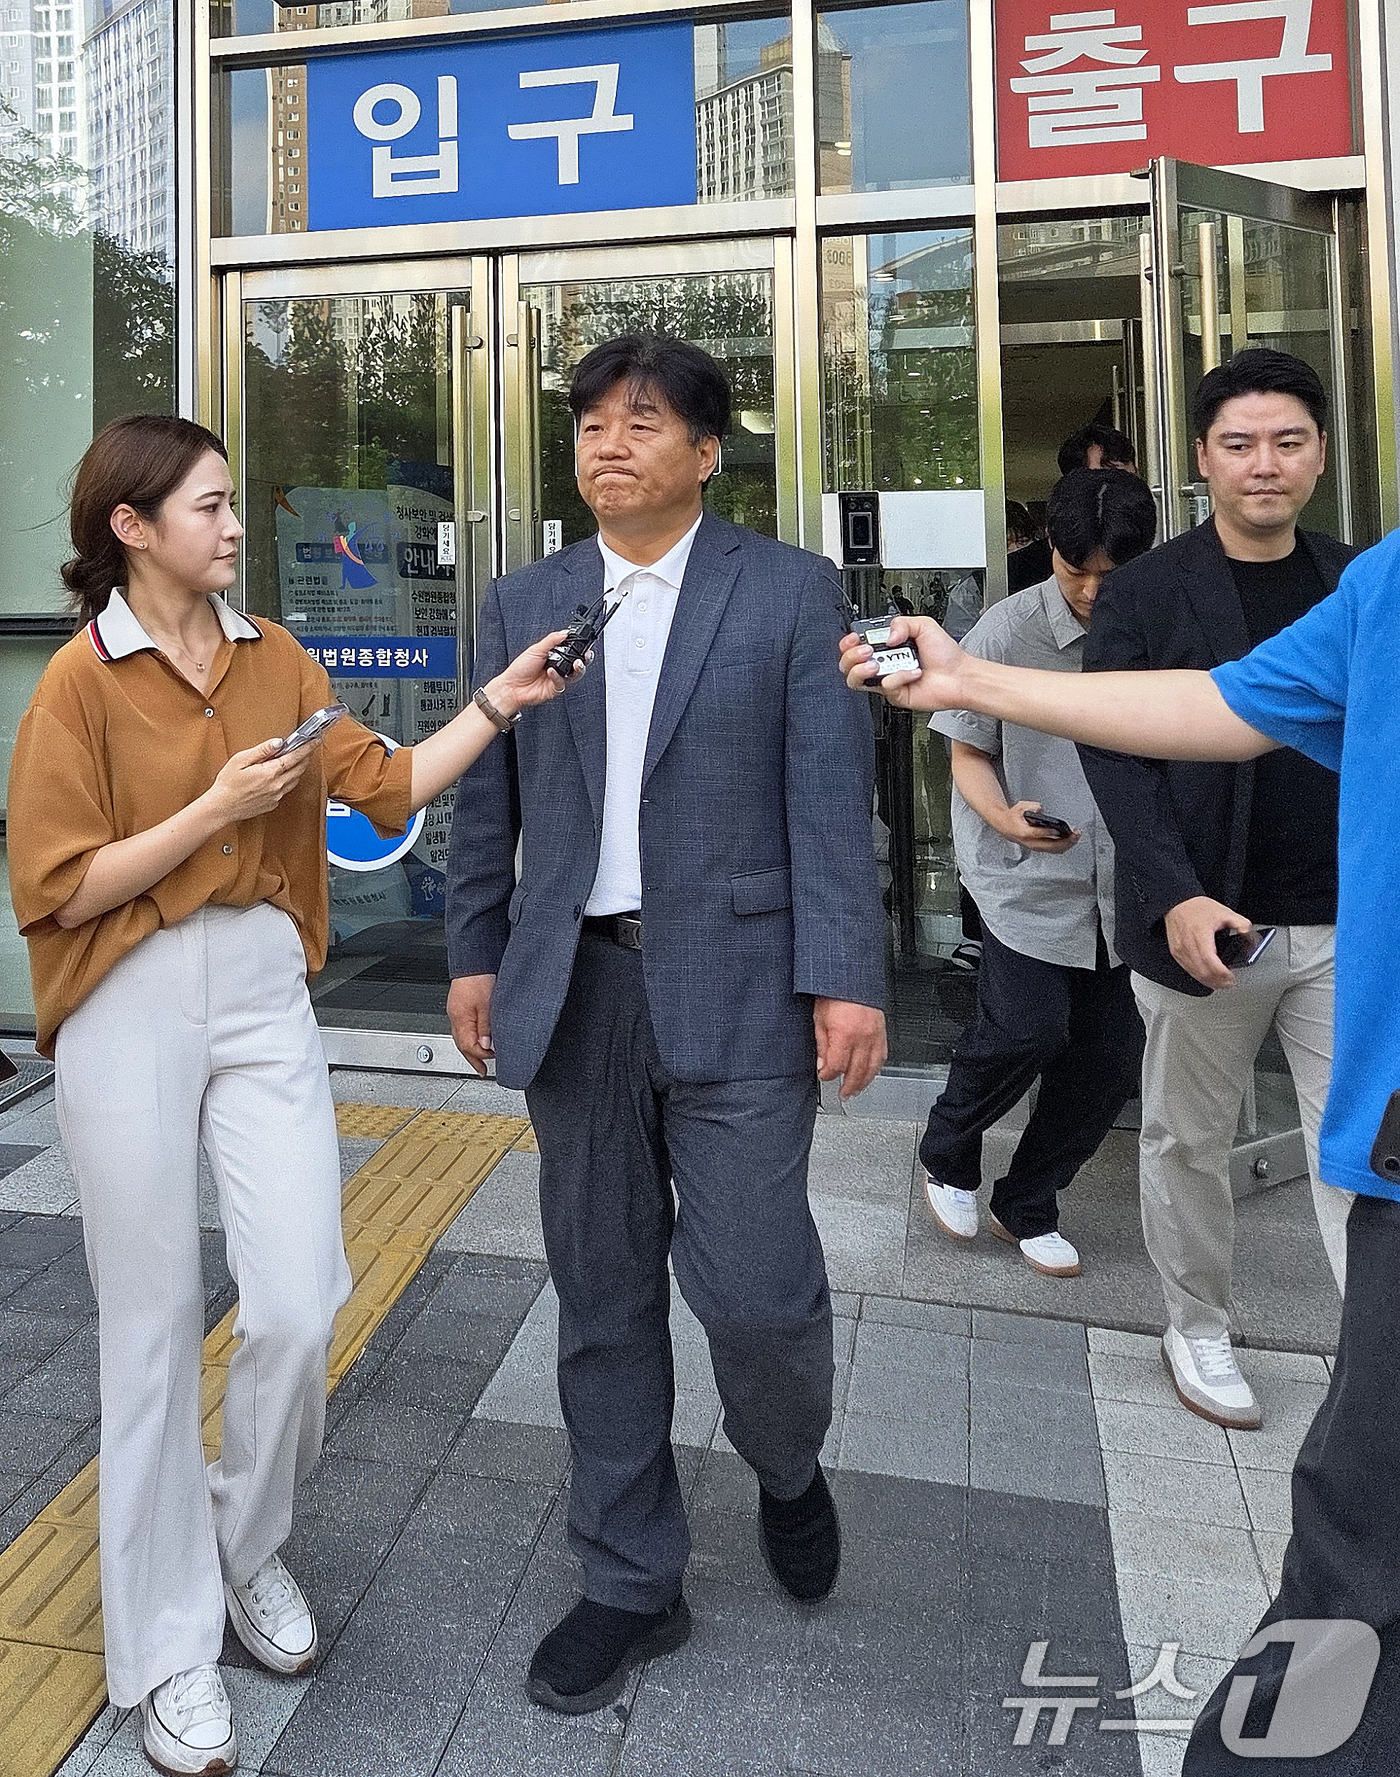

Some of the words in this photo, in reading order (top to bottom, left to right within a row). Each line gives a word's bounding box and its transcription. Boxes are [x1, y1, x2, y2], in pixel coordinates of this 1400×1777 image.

[1010, 0, 1332, 148] 출구
[353, 63, 633, 198] 입구
[442, 524, 450, 555] 당기세요
[886, 650, 911, 662] YTN
